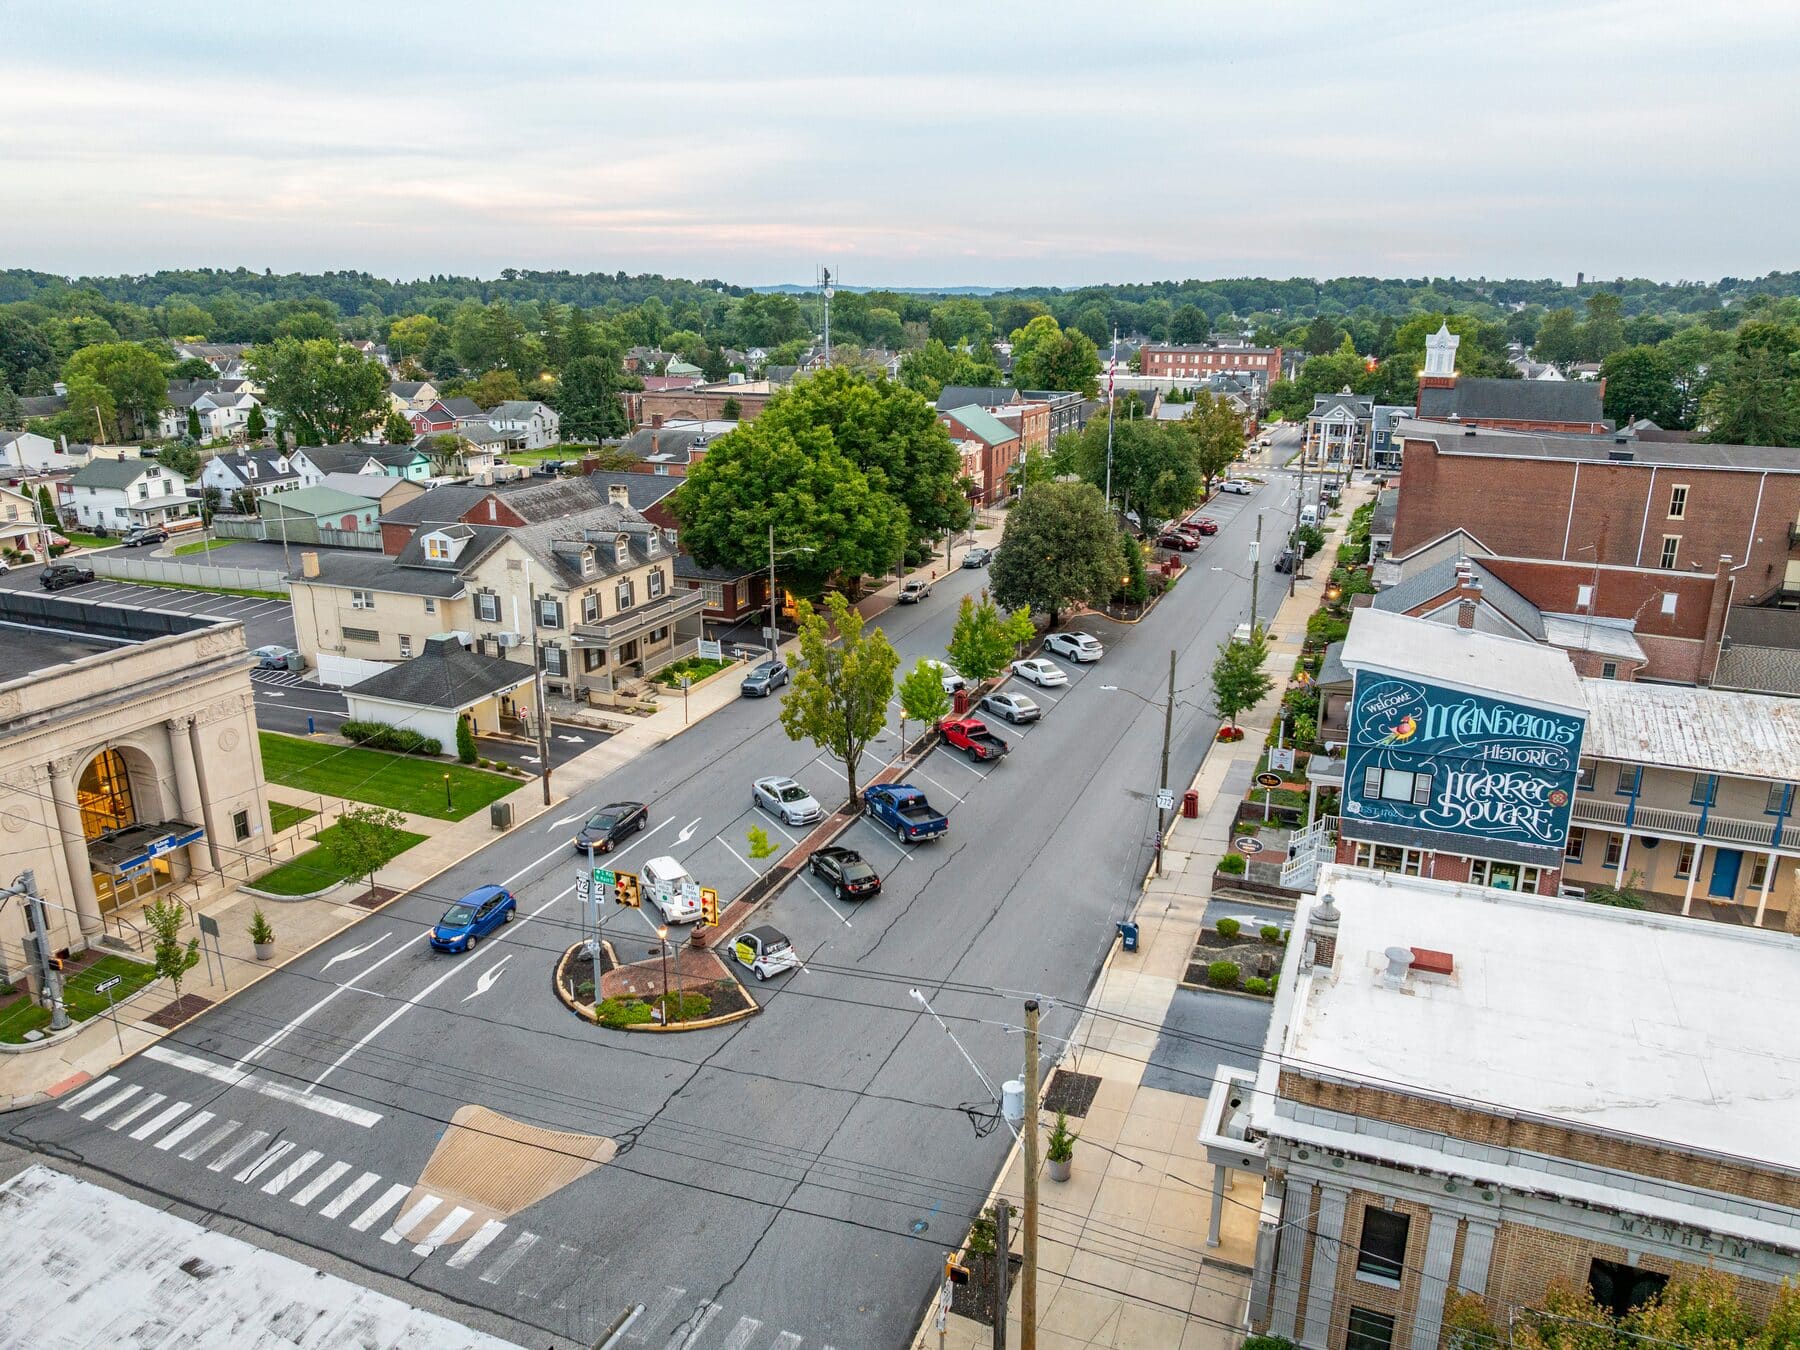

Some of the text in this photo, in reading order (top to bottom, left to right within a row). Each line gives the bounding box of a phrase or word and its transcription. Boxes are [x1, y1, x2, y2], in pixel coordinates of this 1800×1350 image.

[1366, 692, 1412, 713] WELCOME
[1383, 708, 1397, 721] TO
[1484, 744, 1559, 767] HISTORIC
[1159, 798, 1172, 806] 772
[578, 880, 588, 890] 72
[1621, 1218, 1747, 1258] MANHEIM
